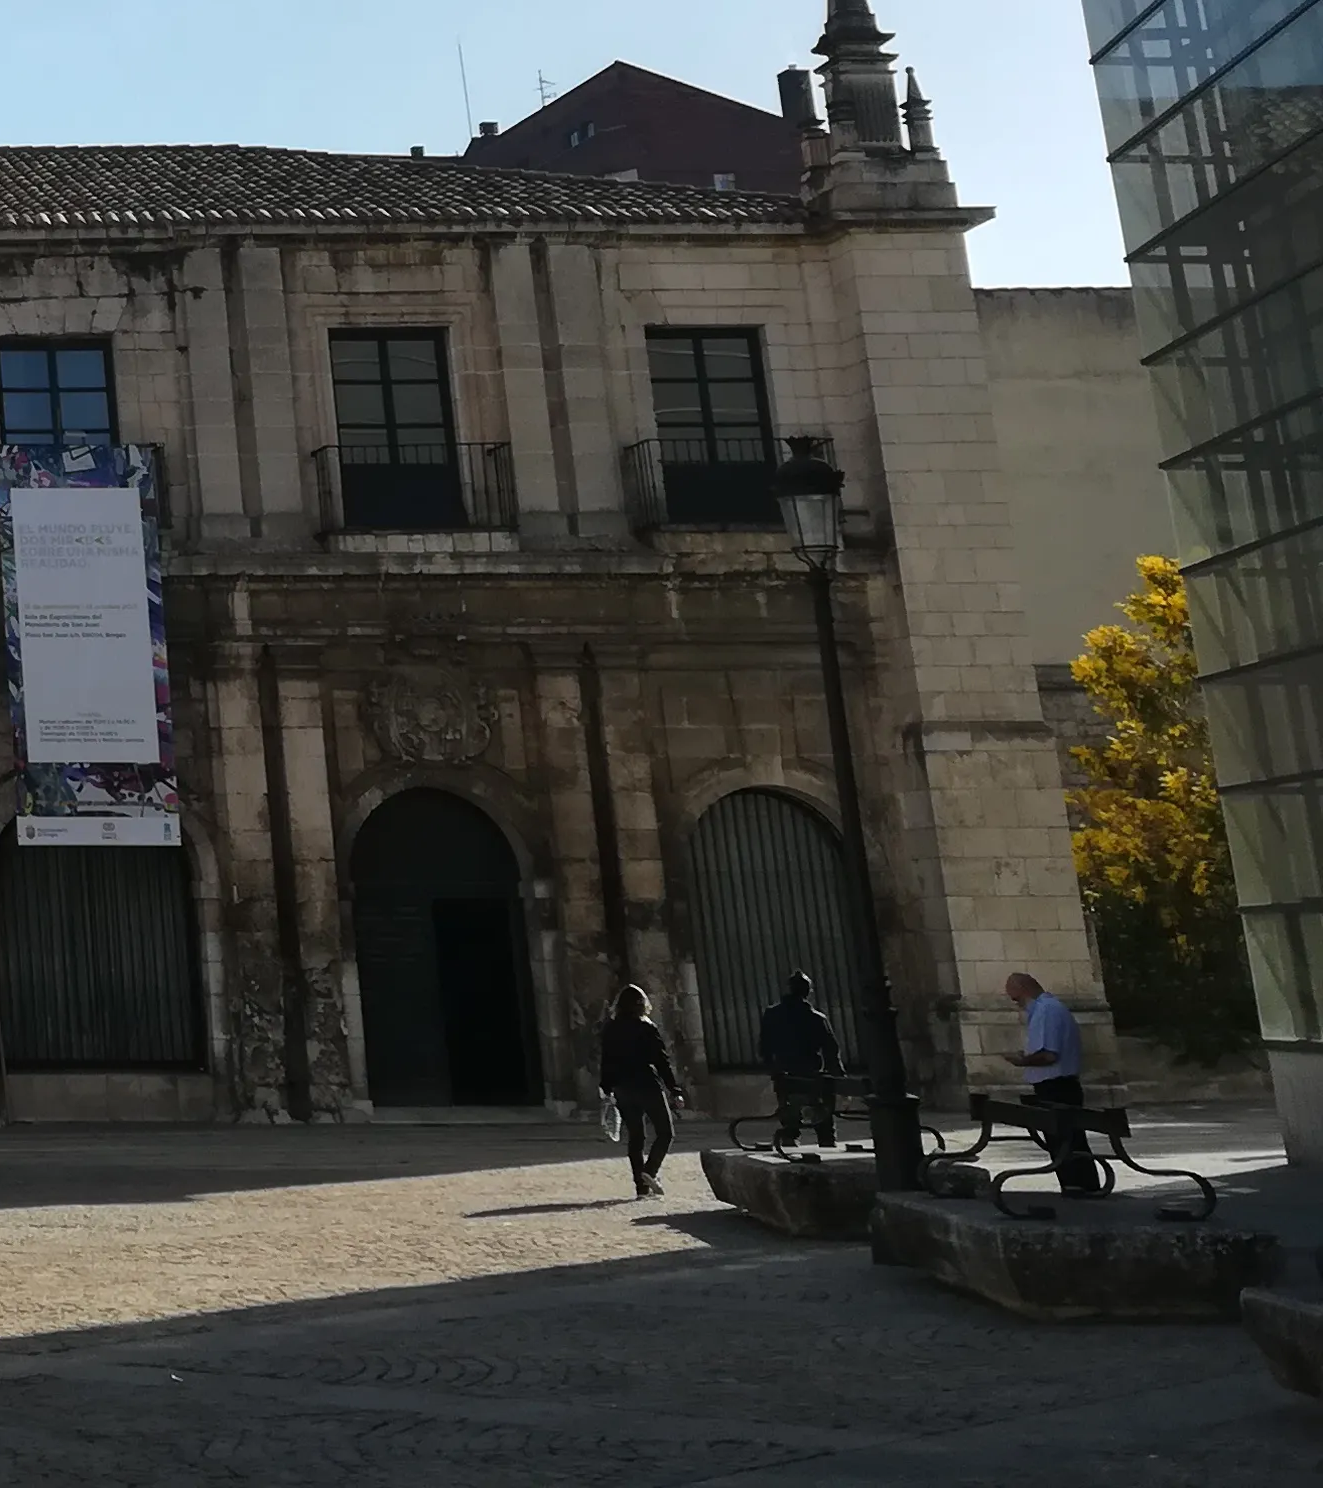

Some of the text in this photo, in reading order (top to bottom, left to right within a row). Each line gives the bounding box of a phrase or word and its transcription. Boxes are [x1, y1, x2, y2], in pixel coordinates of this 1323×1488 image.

[38, 524, 87, 534] MUNDO
[20, 536, 46, 545] DOS
[20, 547, 65, 557] SOBRE
